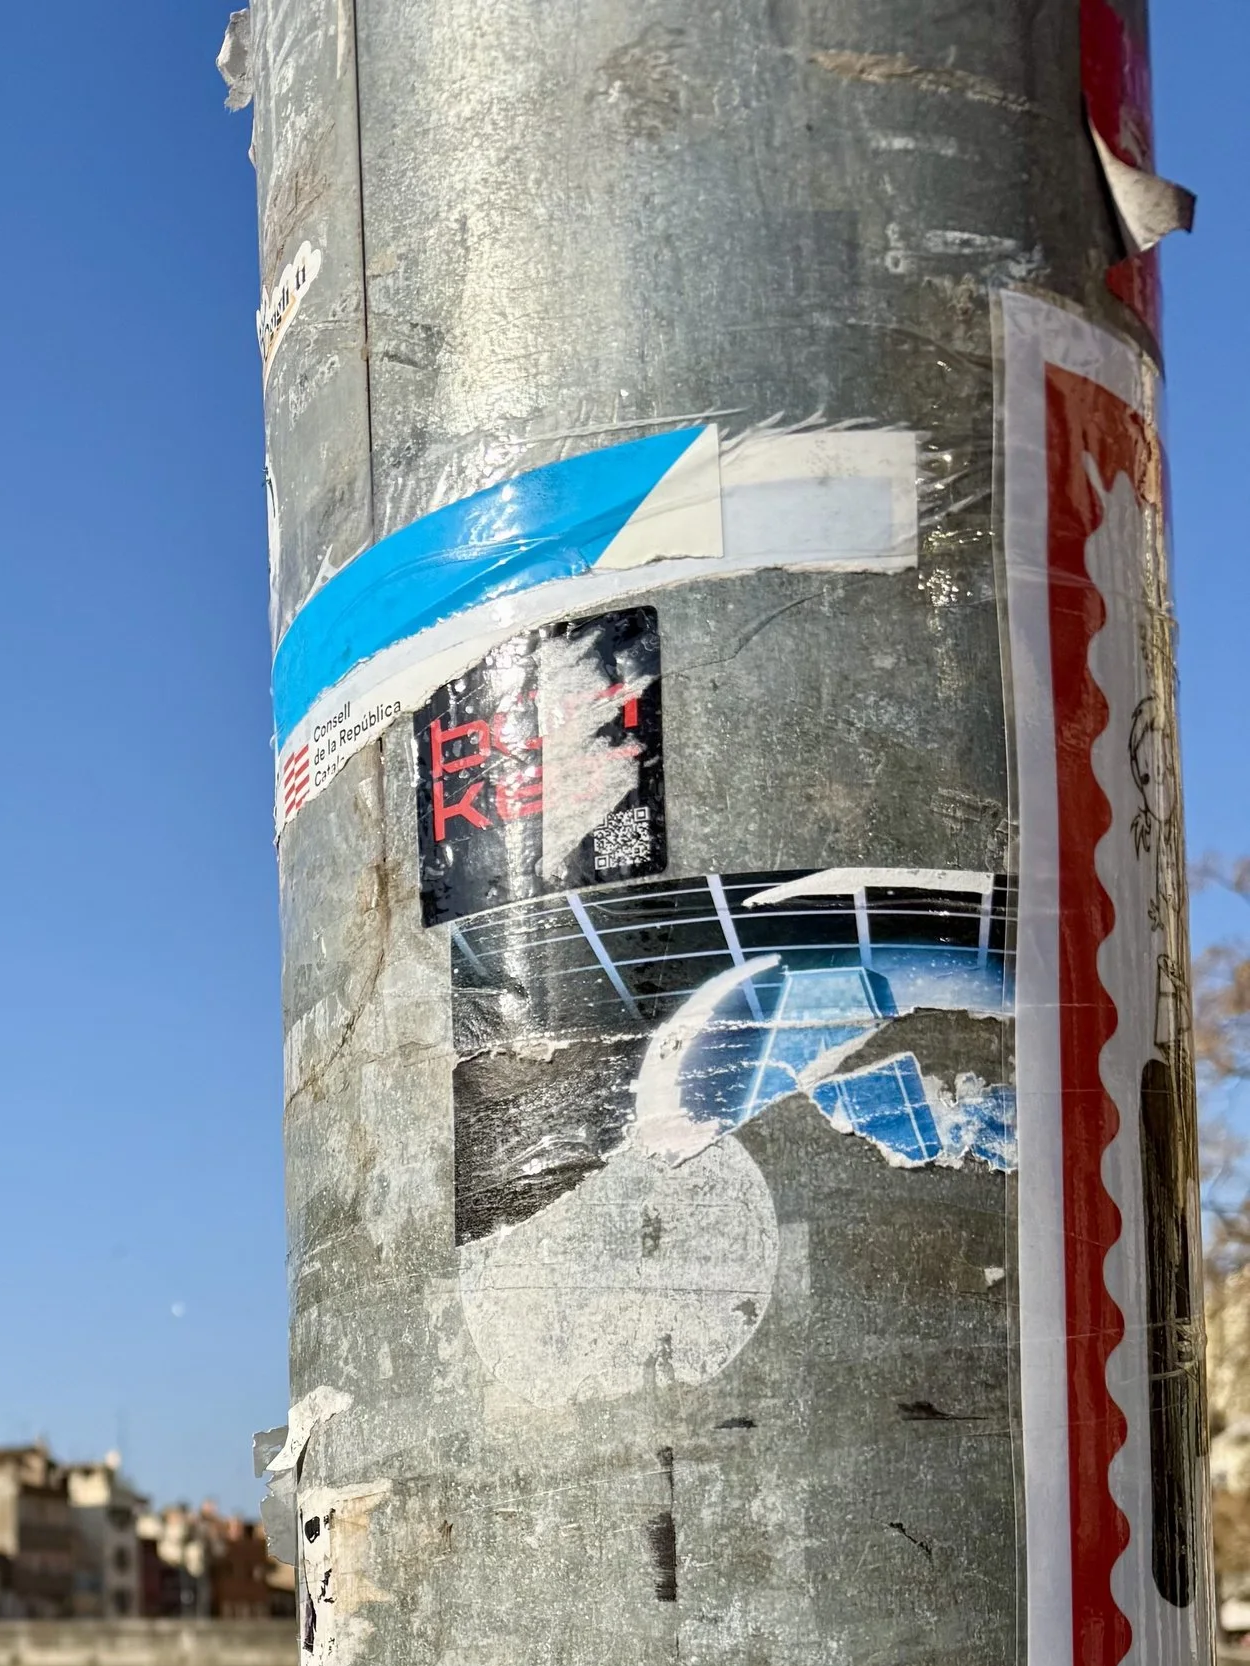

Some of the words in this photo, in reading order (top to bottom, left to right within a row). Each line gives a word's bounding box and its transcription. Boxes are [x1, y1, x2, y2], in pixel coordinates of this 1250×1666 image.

[313, 701, 350, 743] Consell
[314, 749, 325, 766] de
[327, 739, 336, 755] la
[339, 700, 401, 746] República
